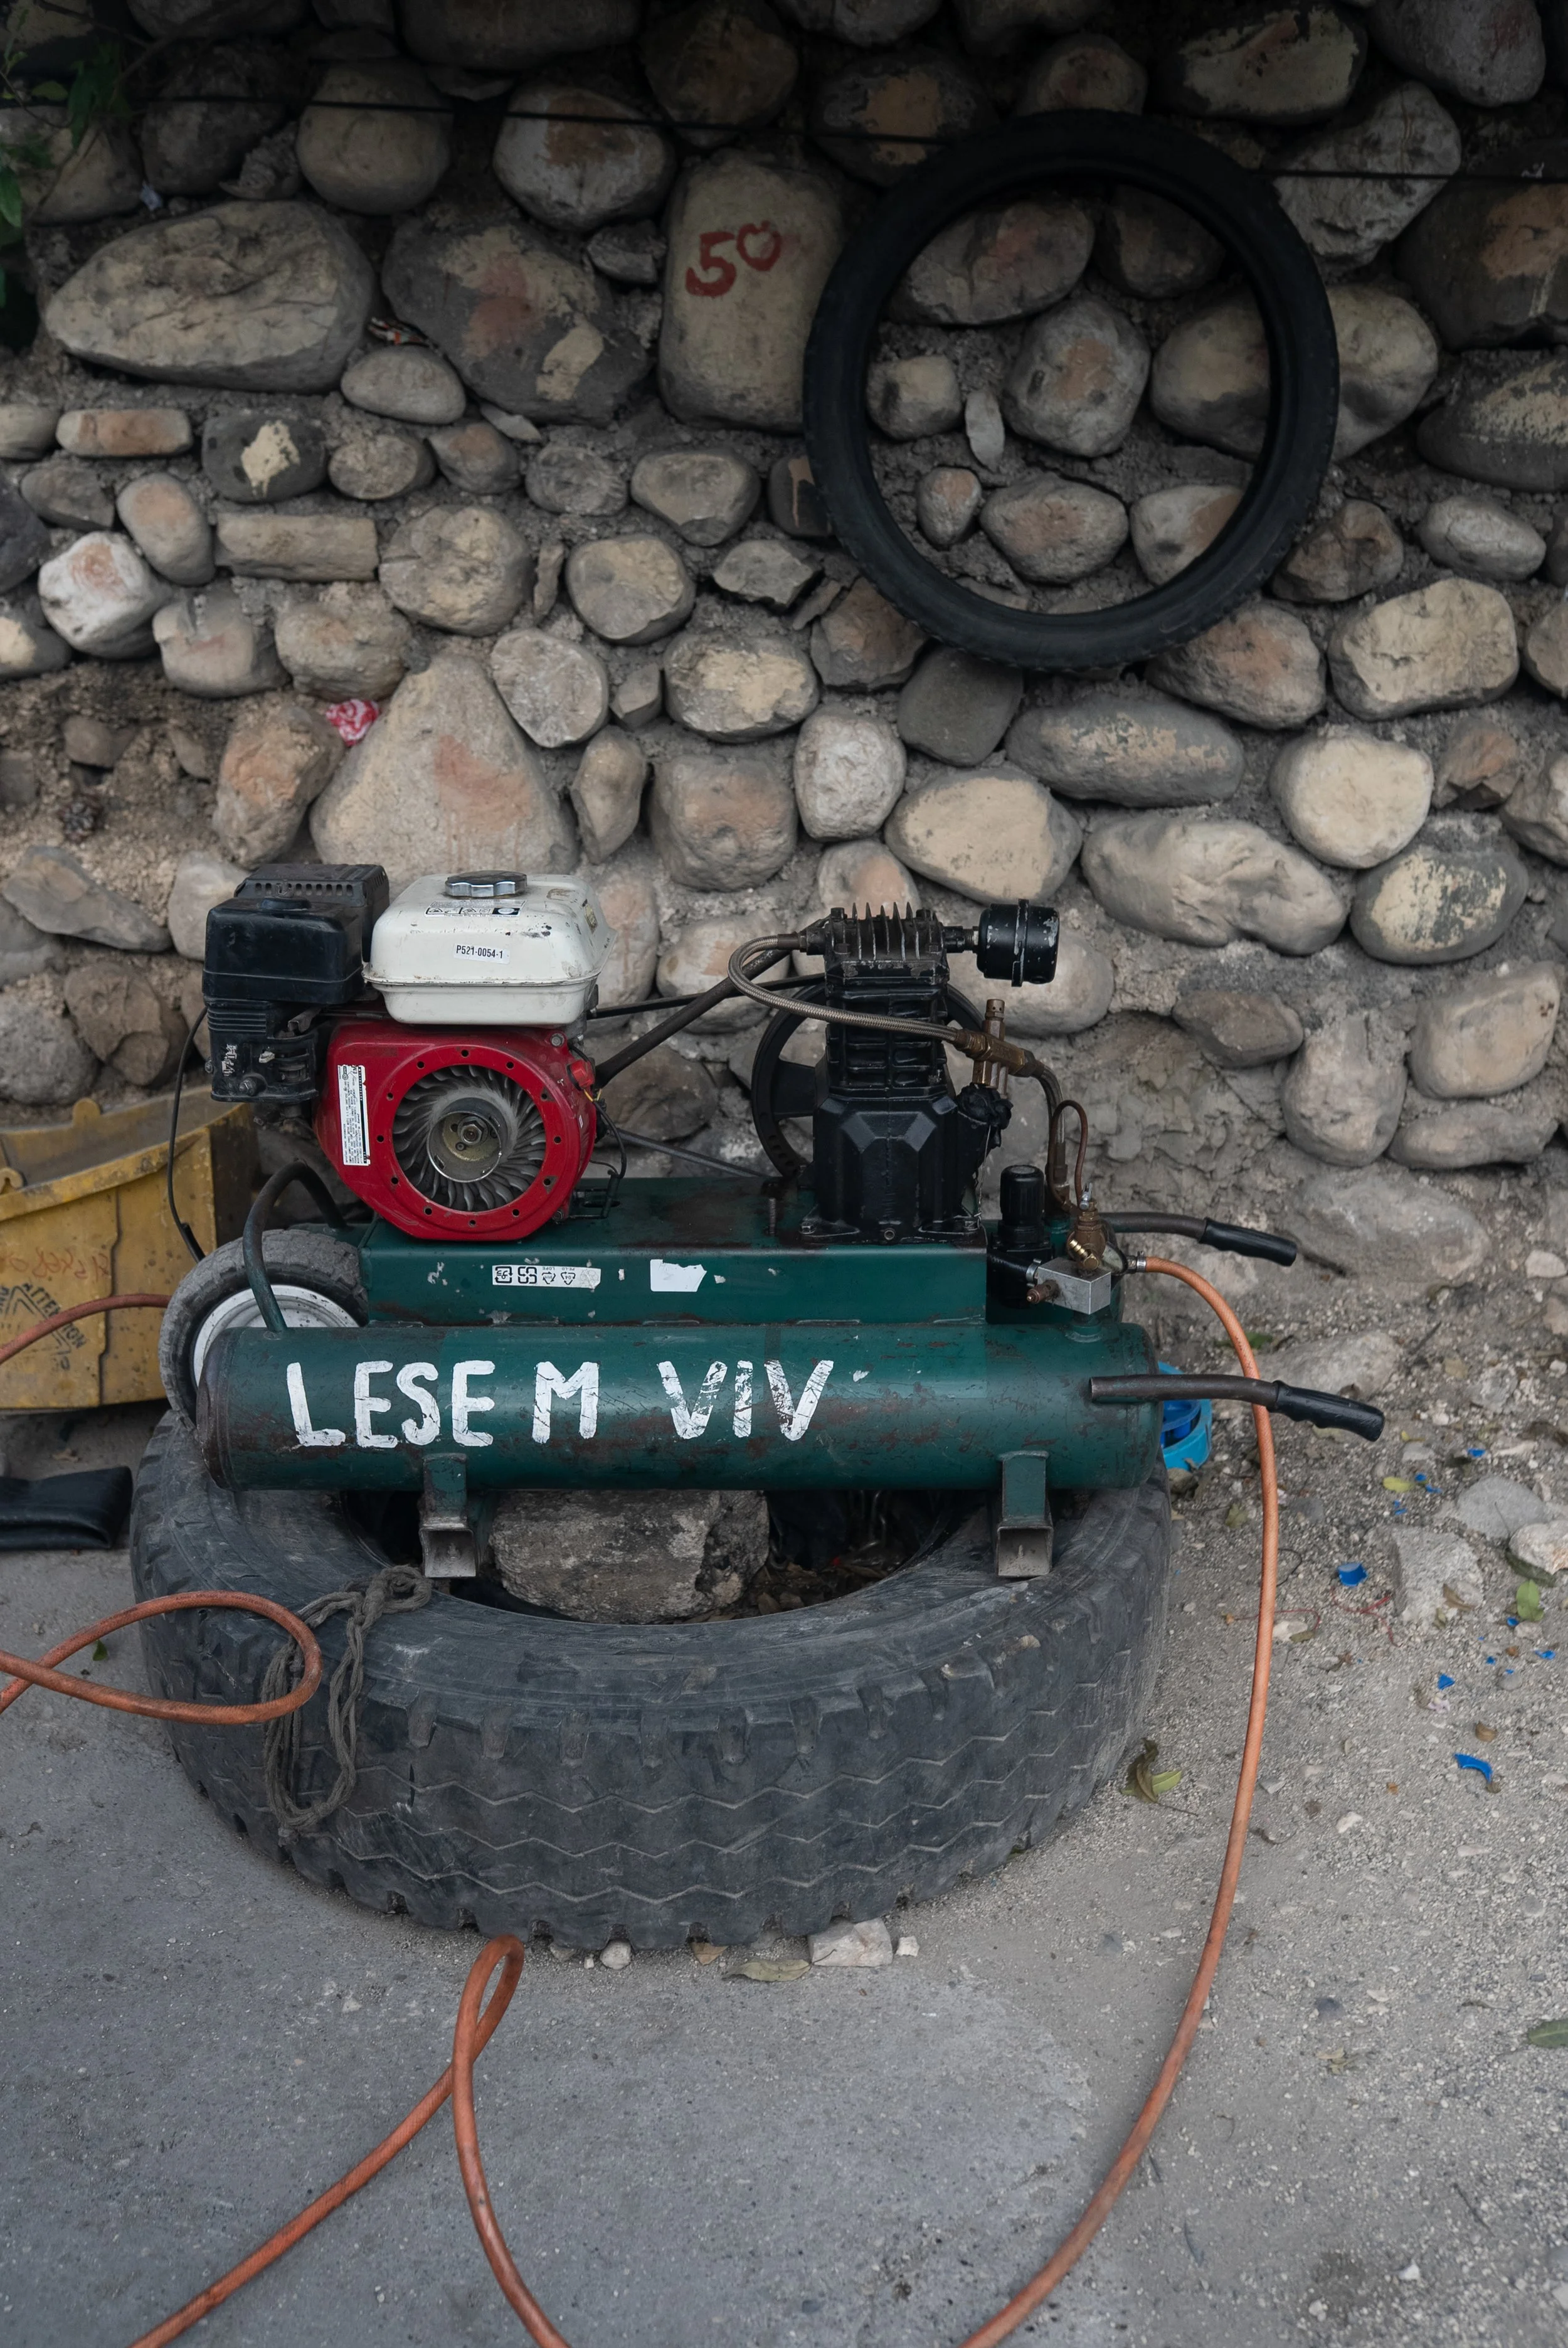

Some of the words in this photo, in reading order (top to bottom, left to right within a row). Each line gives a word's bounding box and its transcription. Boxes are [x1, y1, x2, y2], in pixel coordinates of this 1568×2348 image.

[685, 220, 783, 299] 50
[457, 945, 503, 959] P521-0054-1
[22, 1283, 88, 1349] ATTENION
[287, 1359, 497, 1448] LESE
[532, 1361, 600, 1443] M
[658, 1359, 835, 1441] VIV
